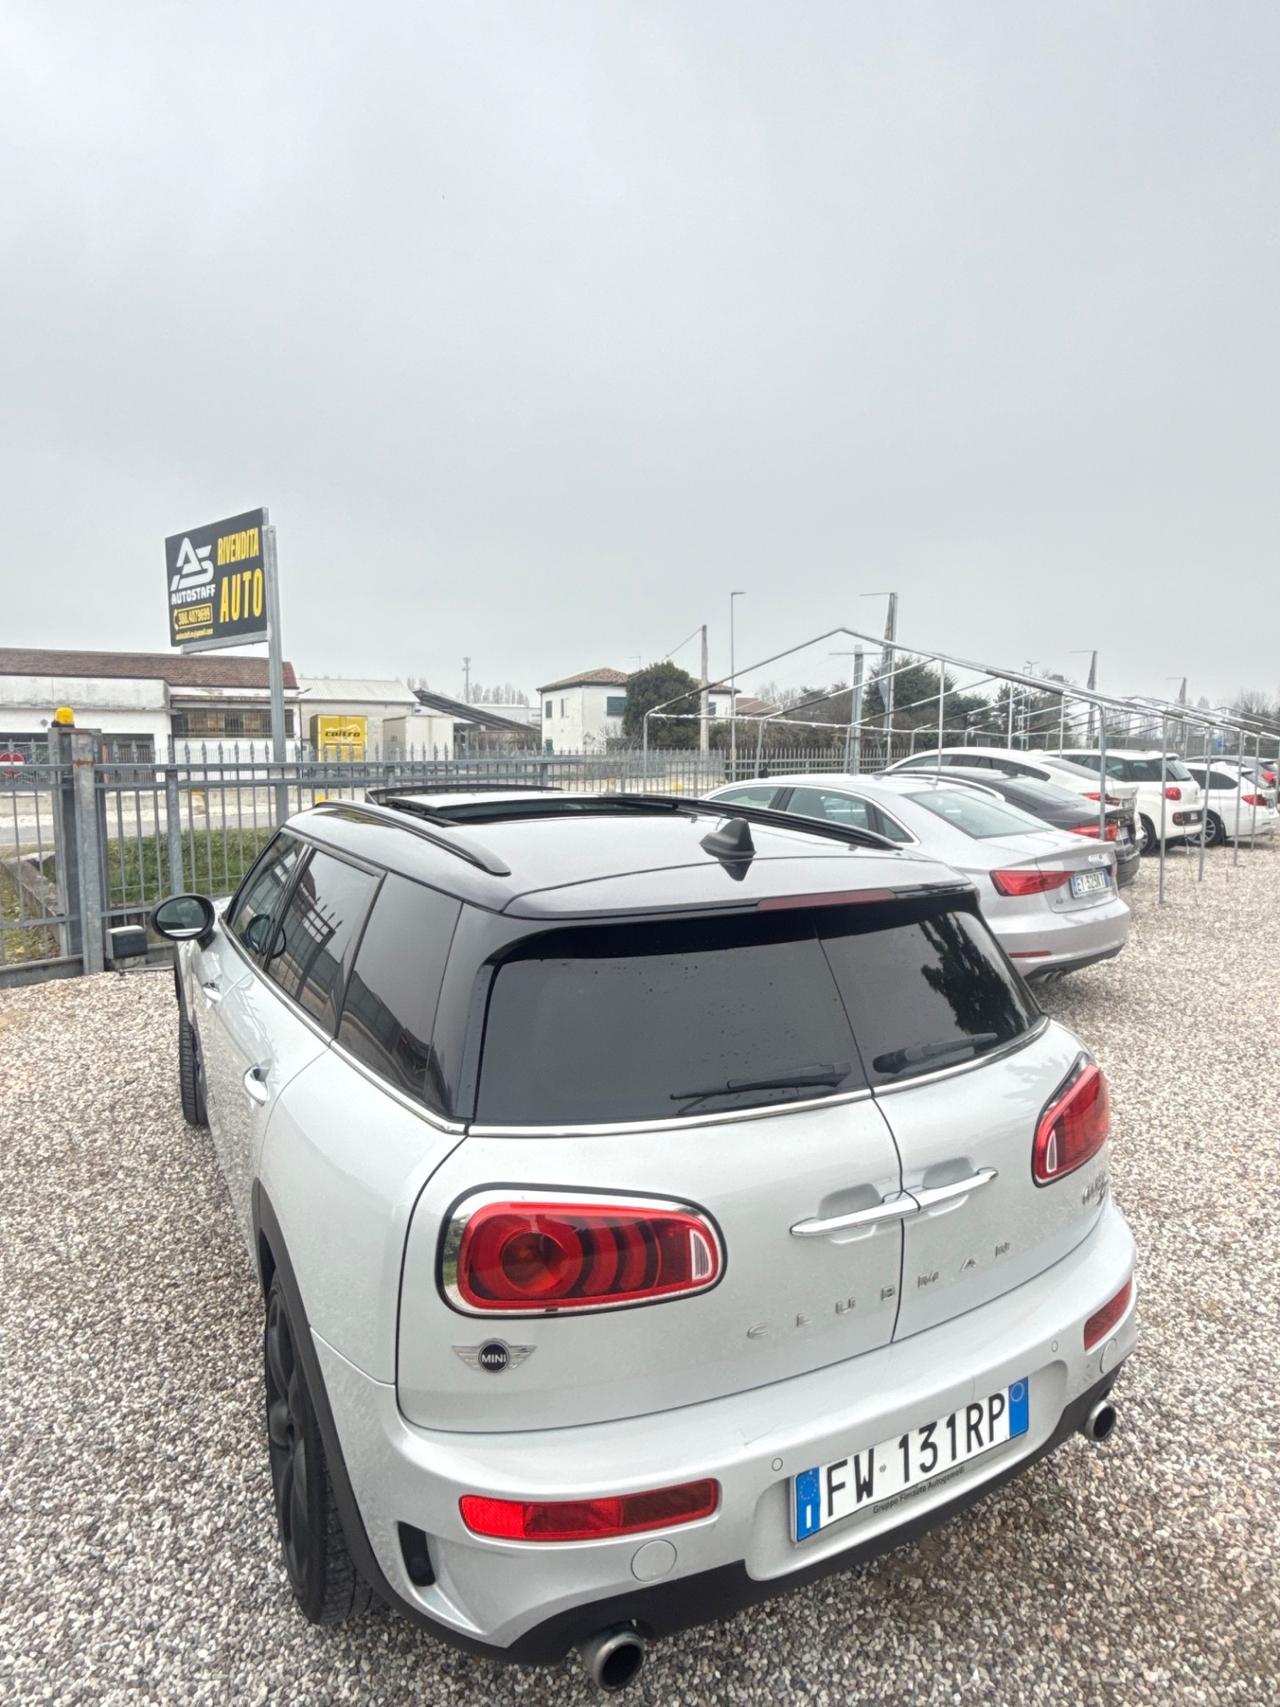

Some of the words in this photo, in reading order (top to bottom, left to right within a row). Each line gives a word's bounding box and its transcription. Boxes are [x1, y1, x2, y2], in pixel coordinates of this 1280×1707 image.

[217, 527, 259, 566] RIVENDITA
[171, 584, 216, 605] AUTOSTAFF
[219, 568, 263, 623] AUTO
[481, 1354, 507, 1363] MINI
[826, 1448, 874, 1517] FW
[899, 1393, 1005, 1483] 131RP
[873, 1499, 898, 1513] Gruppo
